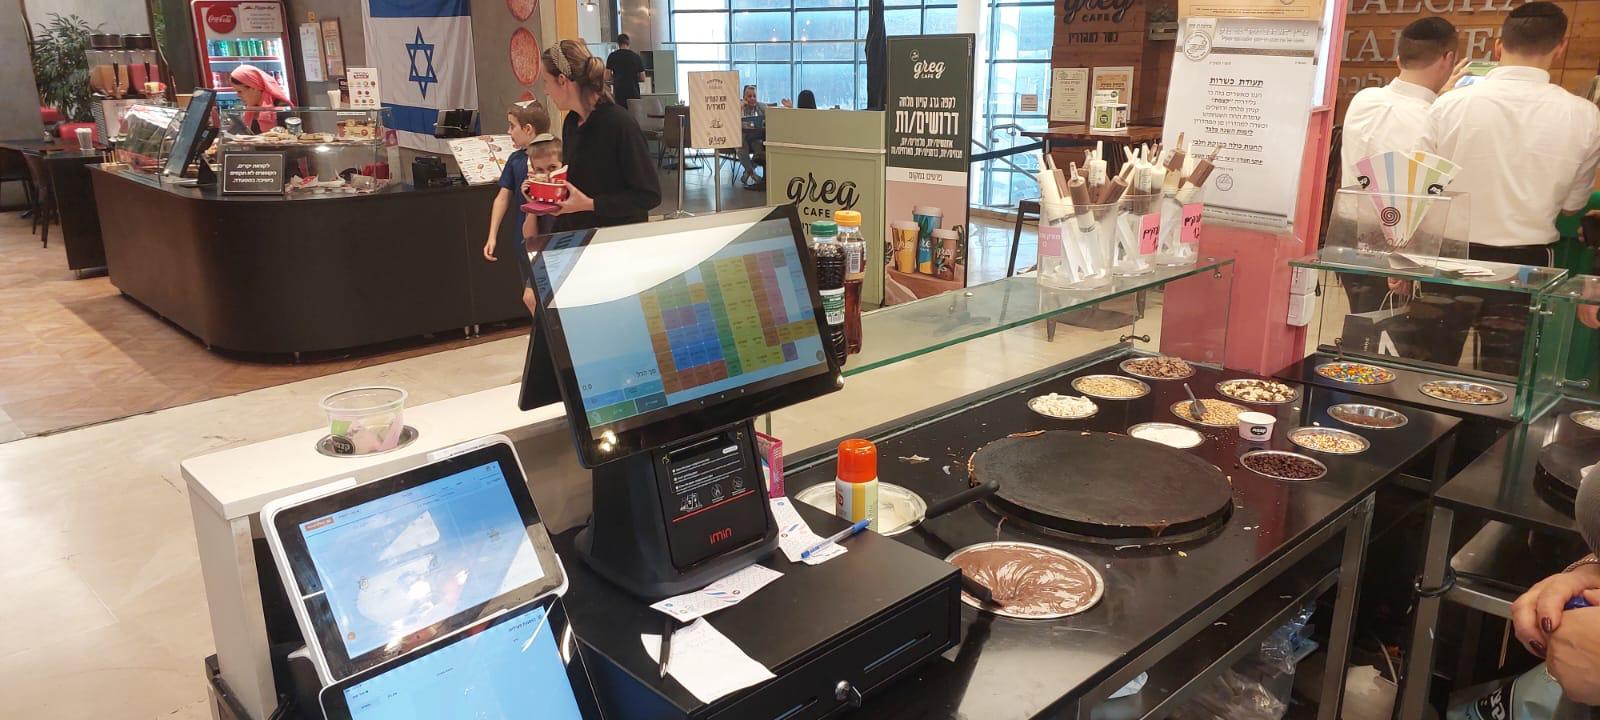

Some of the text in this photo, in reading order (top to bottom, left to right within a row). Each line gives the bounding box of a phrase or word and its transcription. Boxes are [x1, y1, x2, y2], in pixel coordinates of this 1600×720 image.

[1083, 14, 1110, 22] CAFE
[913, 59, 946, 79] greg
[1208, 77, 1264, 87] תעודת כשרות
[898, 95, 957, 109] לקפה גרג קניון מלחה
[895, 110, 960, 136] דרושים/ות
[786, 171, 860, 211] greg
[803, 206, 831, 218] CAFE
